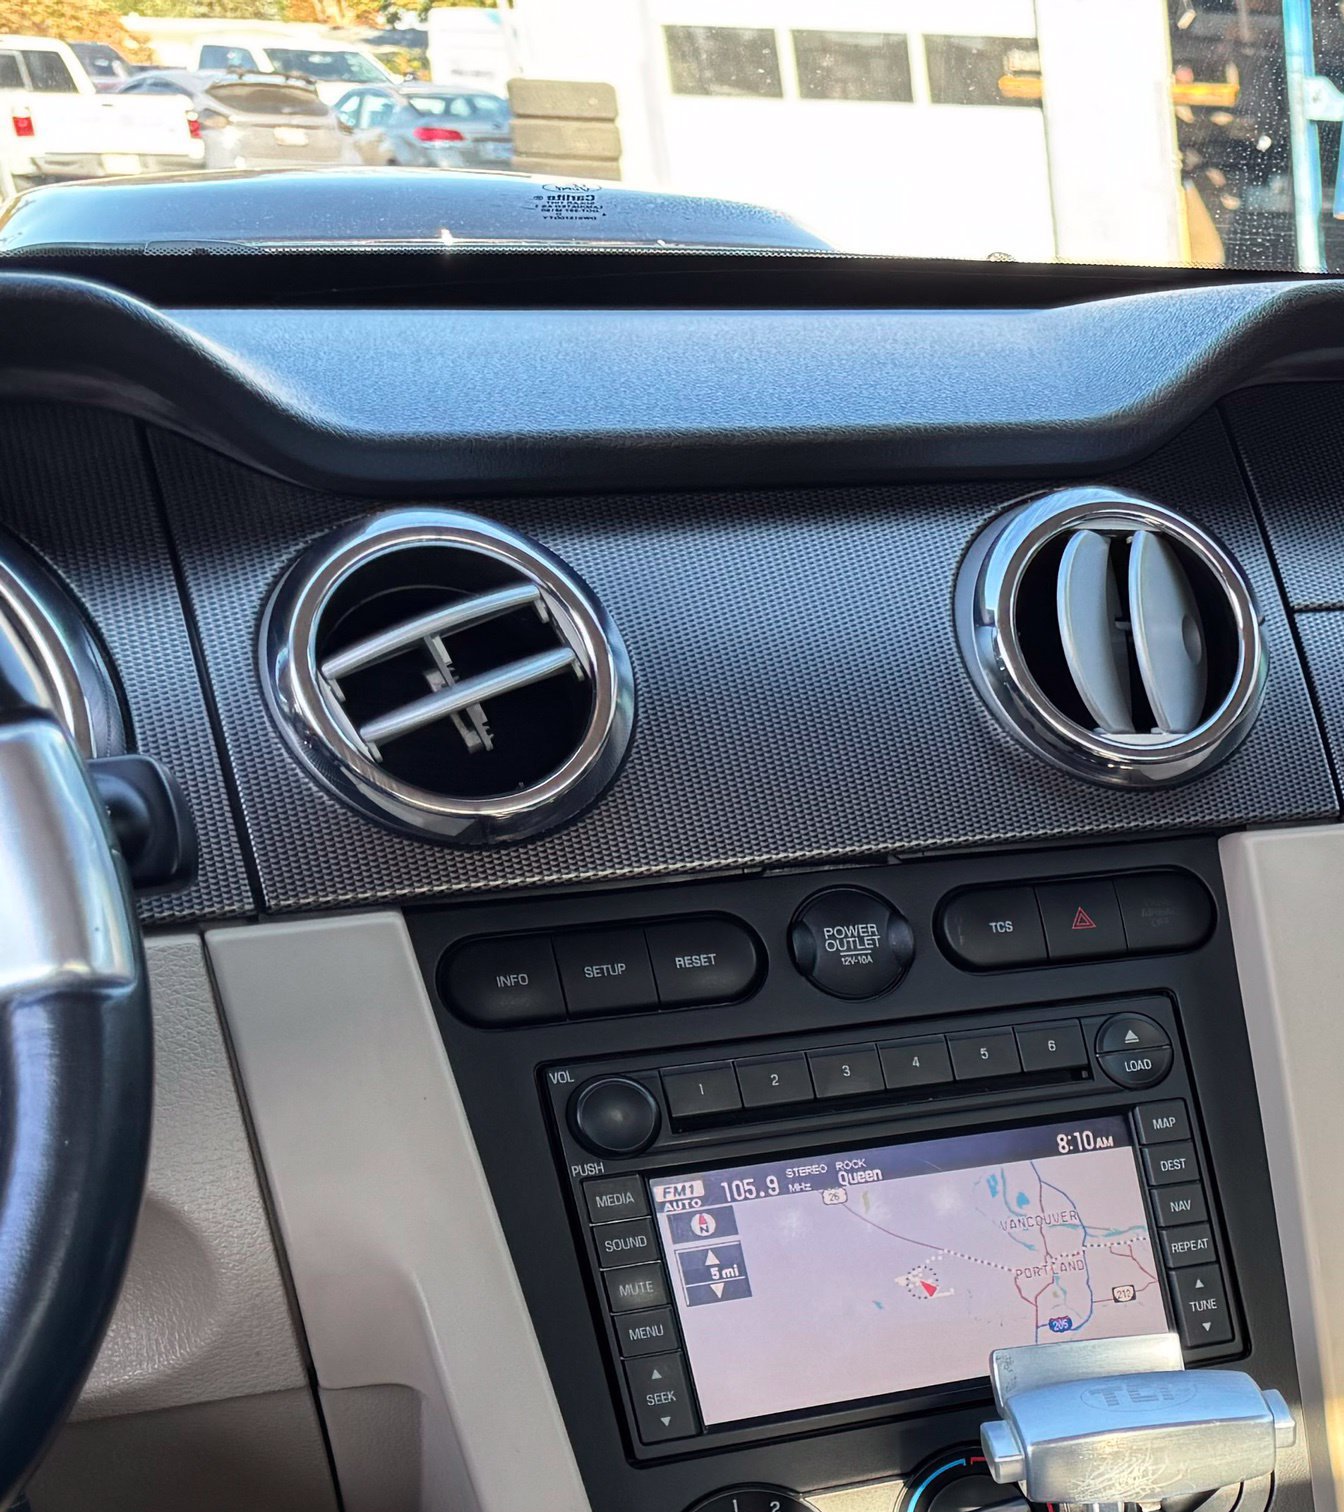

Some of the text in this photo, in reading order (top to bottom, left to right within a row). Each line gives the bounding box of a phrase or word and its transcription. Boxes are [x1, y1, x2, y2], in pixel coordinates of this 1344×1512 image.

[823, 923, 878, 939] POWER
[989, 920, 1014, 933] TCS
[825, 935, 881, 952] OUTLET
[675, 953, 717, 969] RESET
[584, 963, 627, 978] SETUP
[496, 973, 529, 988] INFO
[980, 1047, 989, 1060] 5
[1047, 1040, 1056, 1053] 6
[911, 1056, 920, 1069] 4
[1124, 1058, 1152, 1073] LOAD
[549, 1071, 575, 1085] VOL
[842, 1065, 851, 1078] 3
[770, 1073, 779, 1086] 2
[698, 1083, 705, 1096] 1
[1153, 1116, 1176, 1130] MAP
[571, 1162, 605, 1177] PUSH
[785, 1163, 828, 1179] STEREO
[835, 1158, 867, 1171] ROCK
[1160, 1158, 1187, 1172] DEST
[838, 1168, 883, 1187] Queen
[662, 1183, 697, 1200] FM1
[721, 1175, 780, 1203] 105.9
[596, 1191, 635, 1208] MEDIA
[663, 1199, 702, 1213] AUTO
[1169, 1199, 1192, 1213] NAV
[1000, 1210, 1078, 1231] VANCOUVER
[699, 1223, 710, 1235] N
[604, 1234, 648, 1252] SOUND
[1171, 1238, 1209, 1254] REPEAT
[710, 1264, 739, 1280] 5 mi
[1015, 1259, 1085, 1279] PORTLAND
[618, 1280, 654, 1297] MUTE
[1189, 1299, 1218, 1312] TUNE
[629, 1324, 664, 1341] MENU
[646, 1390, 676, 1406] SEEK
[732, 1499, 739, 1512] 1
